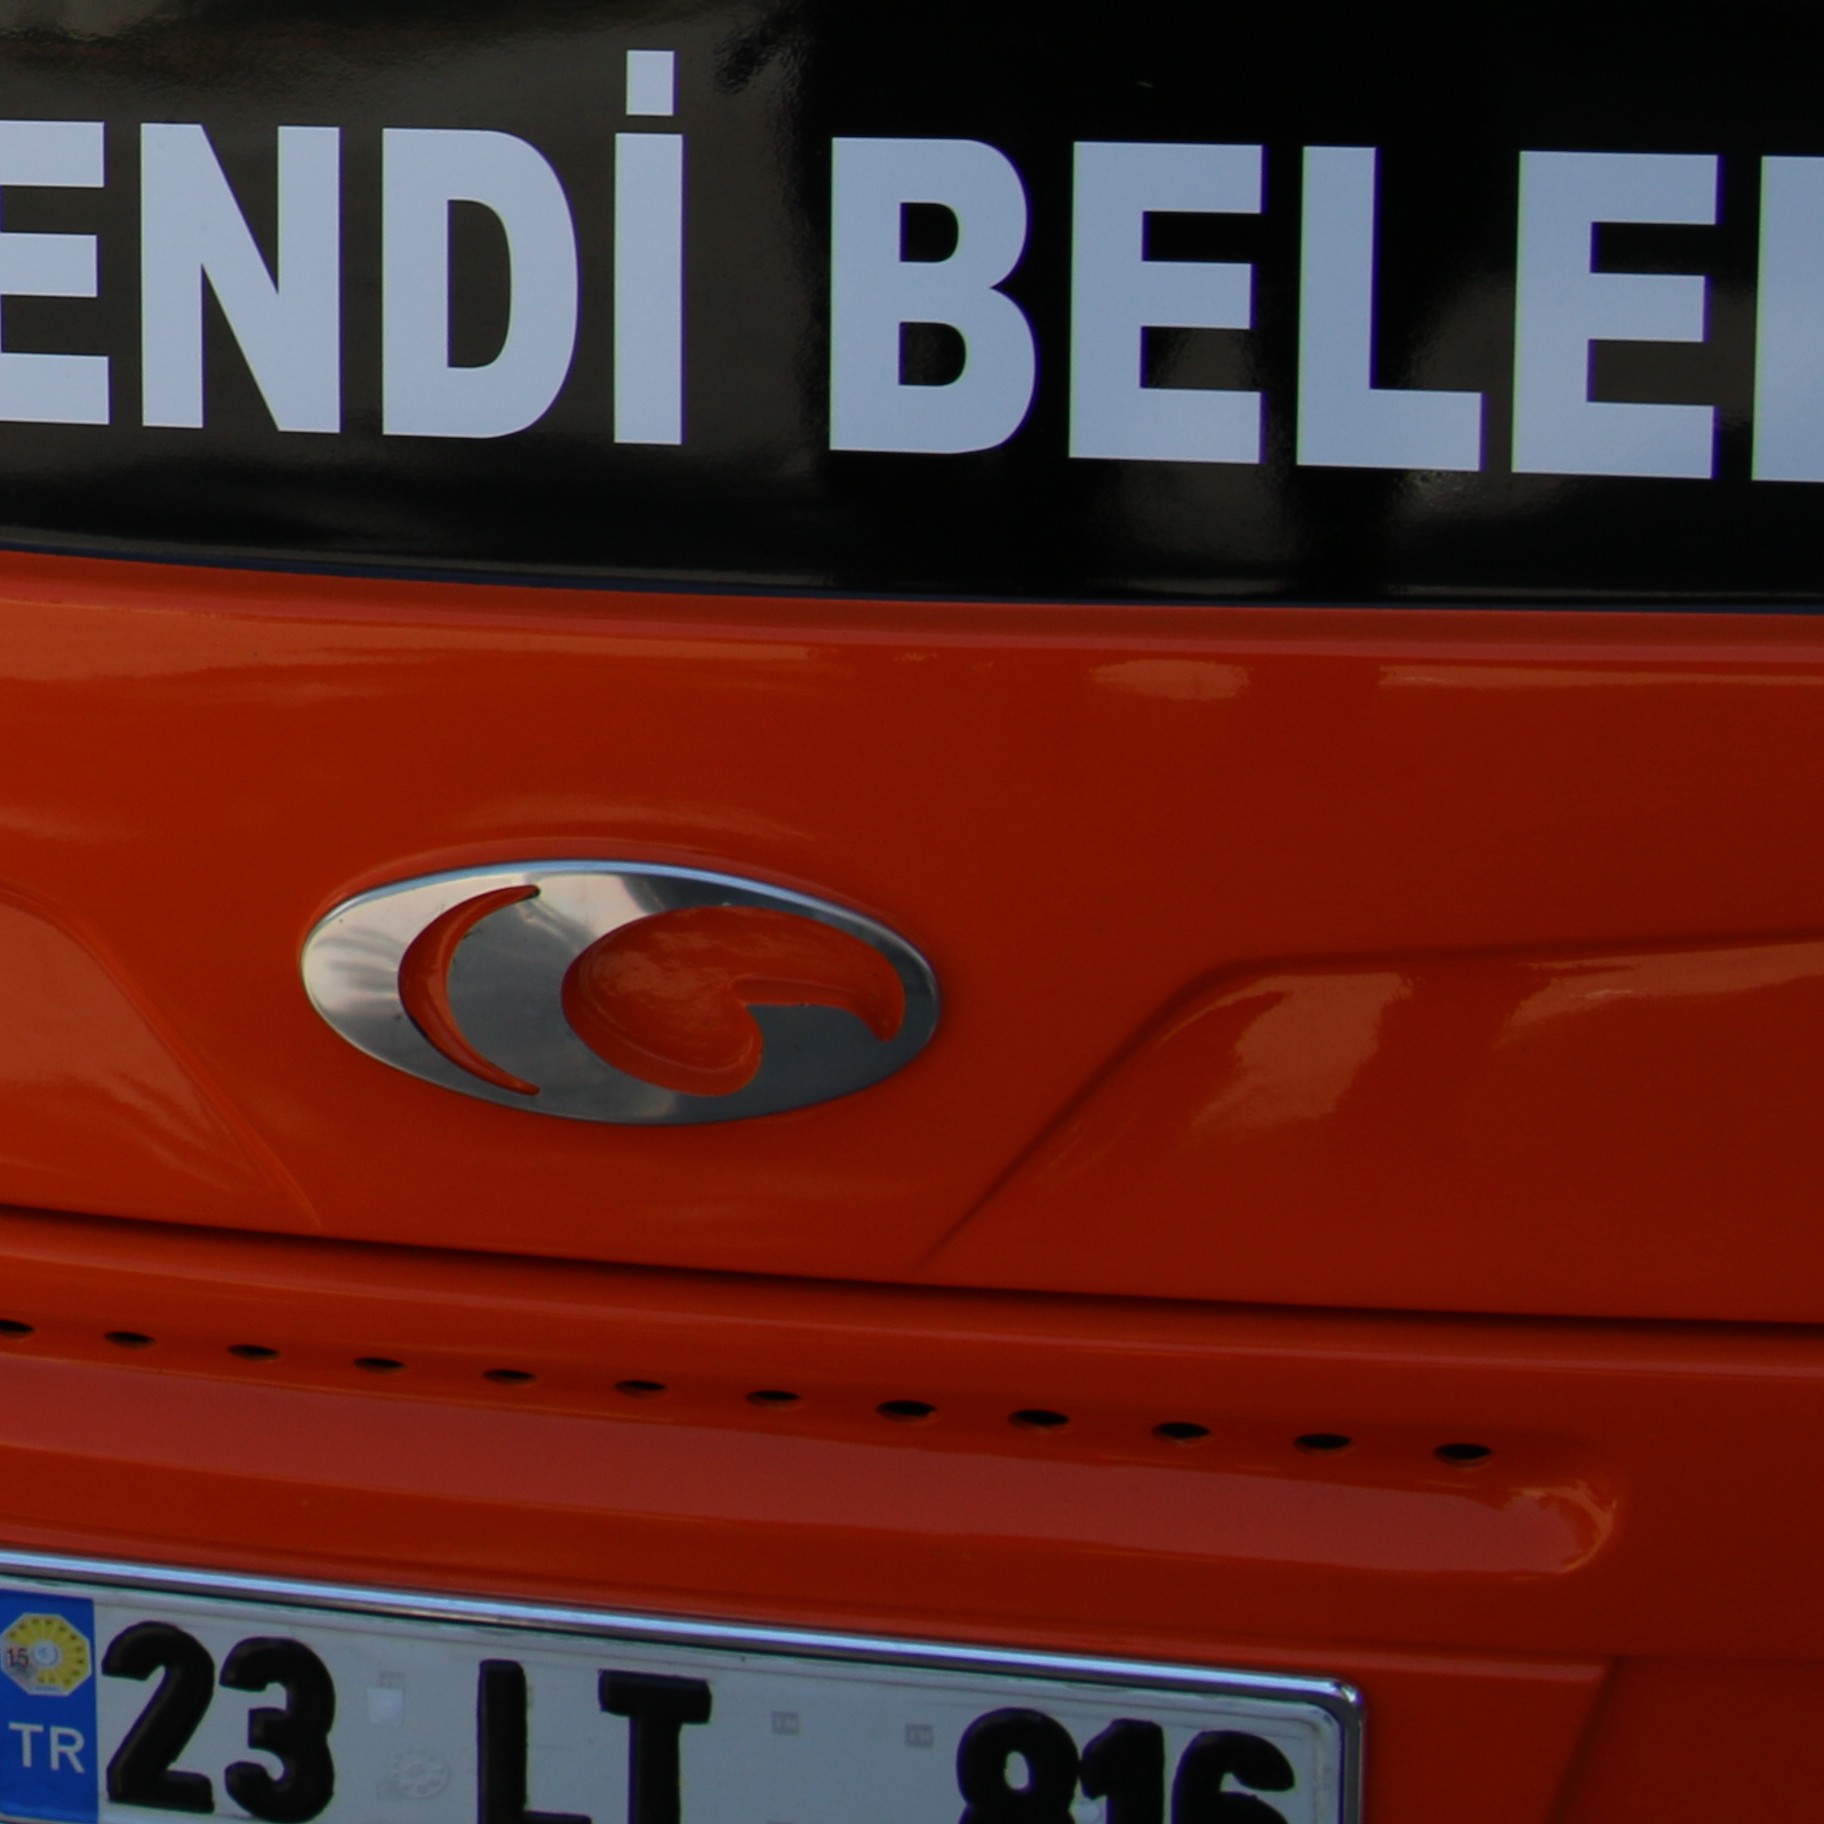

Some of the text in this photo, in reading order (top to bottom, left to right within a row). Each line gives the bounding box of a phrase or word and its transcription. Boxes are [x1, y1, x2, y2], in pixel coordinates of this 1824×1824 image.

[8, 1721, 85, 1774] TR
[101, 1620, 336, 1824] 23
[477, 1659, 712, 1824] LT
